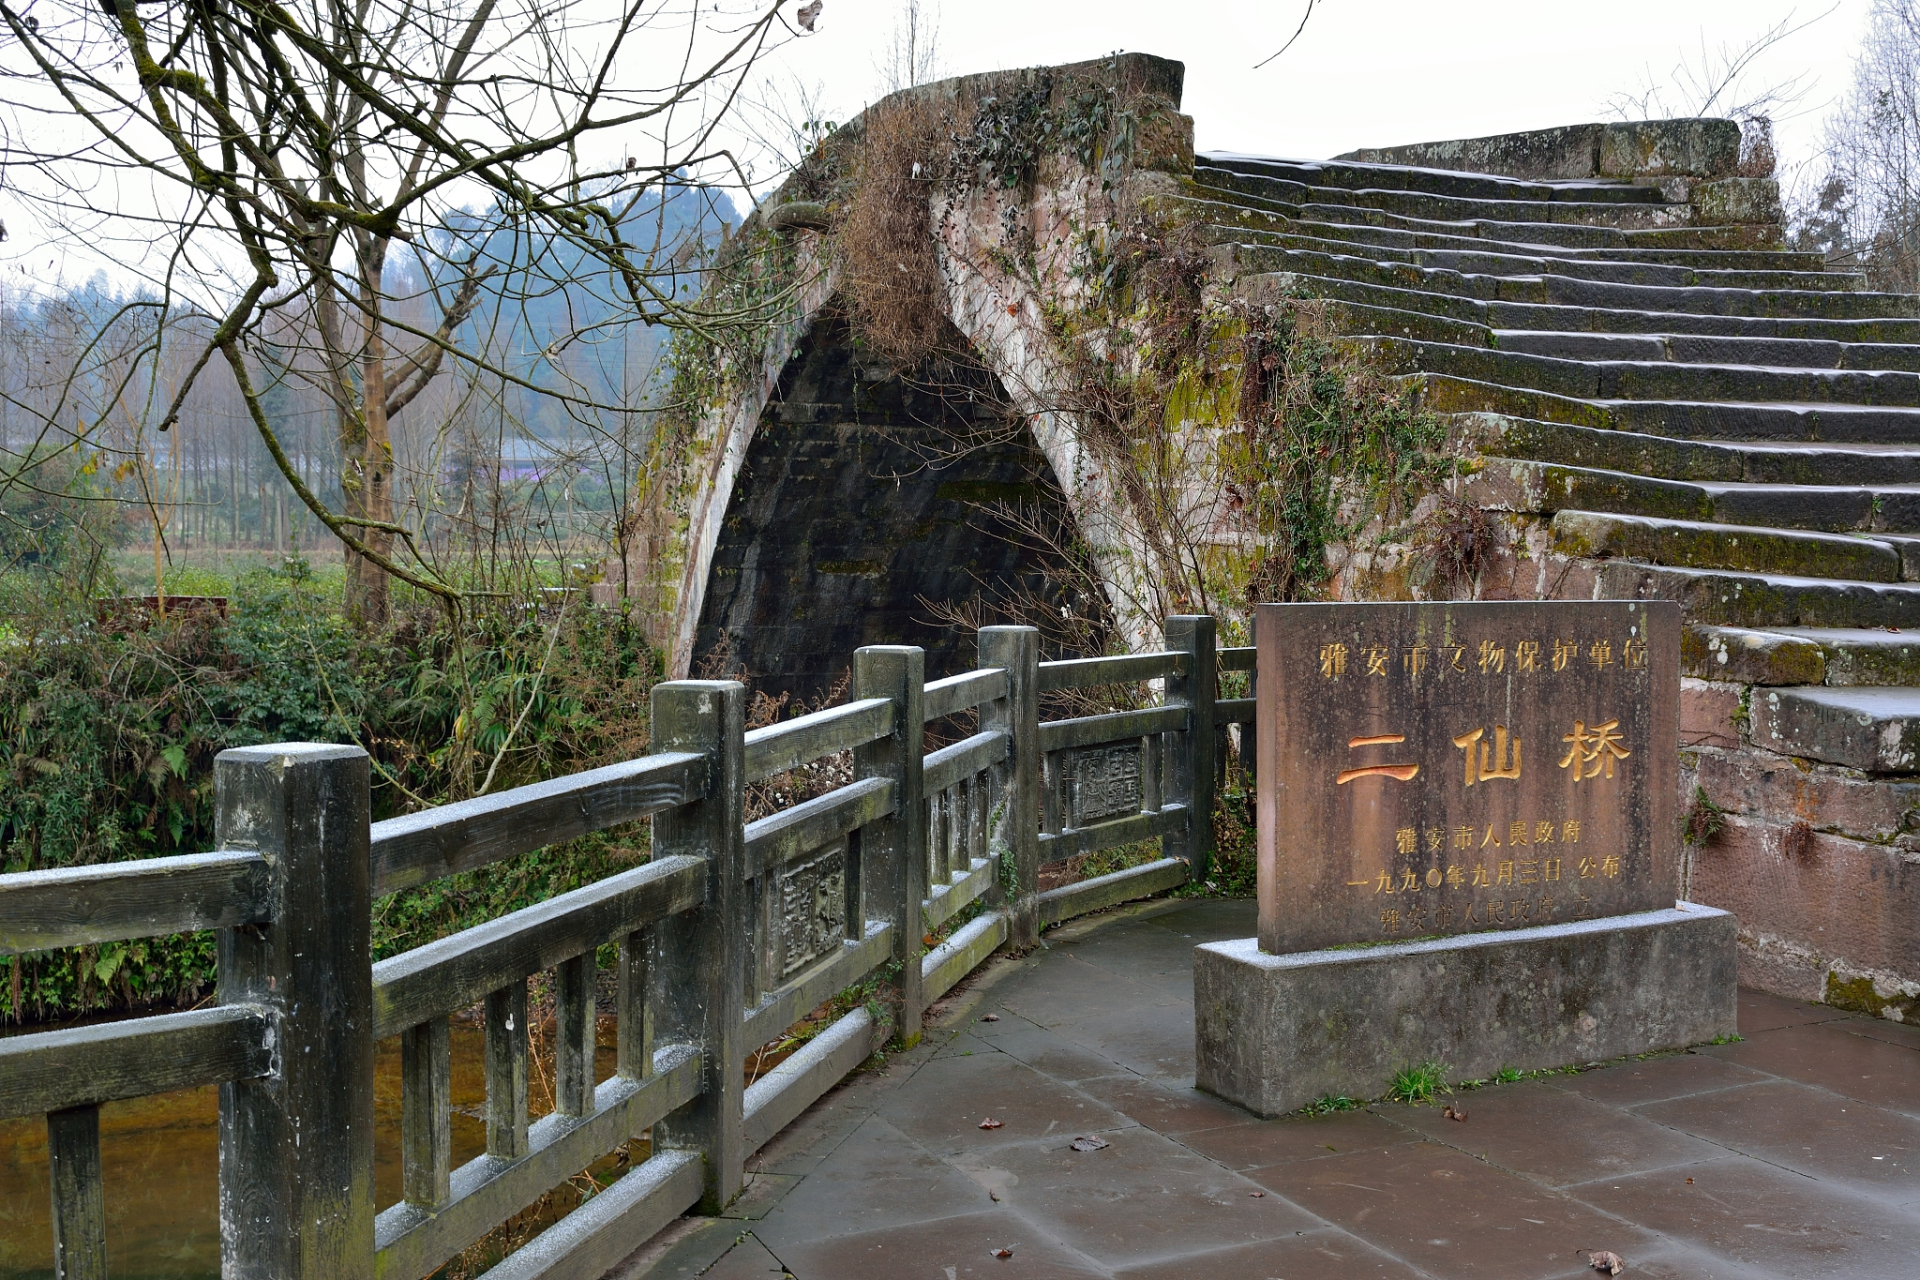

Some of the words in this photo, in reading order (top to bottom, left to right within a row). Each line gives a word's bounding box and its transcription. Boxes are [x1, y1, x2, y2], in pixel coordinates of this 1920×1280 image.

[1320, 638, 1647, 678] 雅安市文物保护单位
[1336, 718, 1630, 786] 二仙桥
[1396, 818, 1582, 854] 雅安市人民政府
